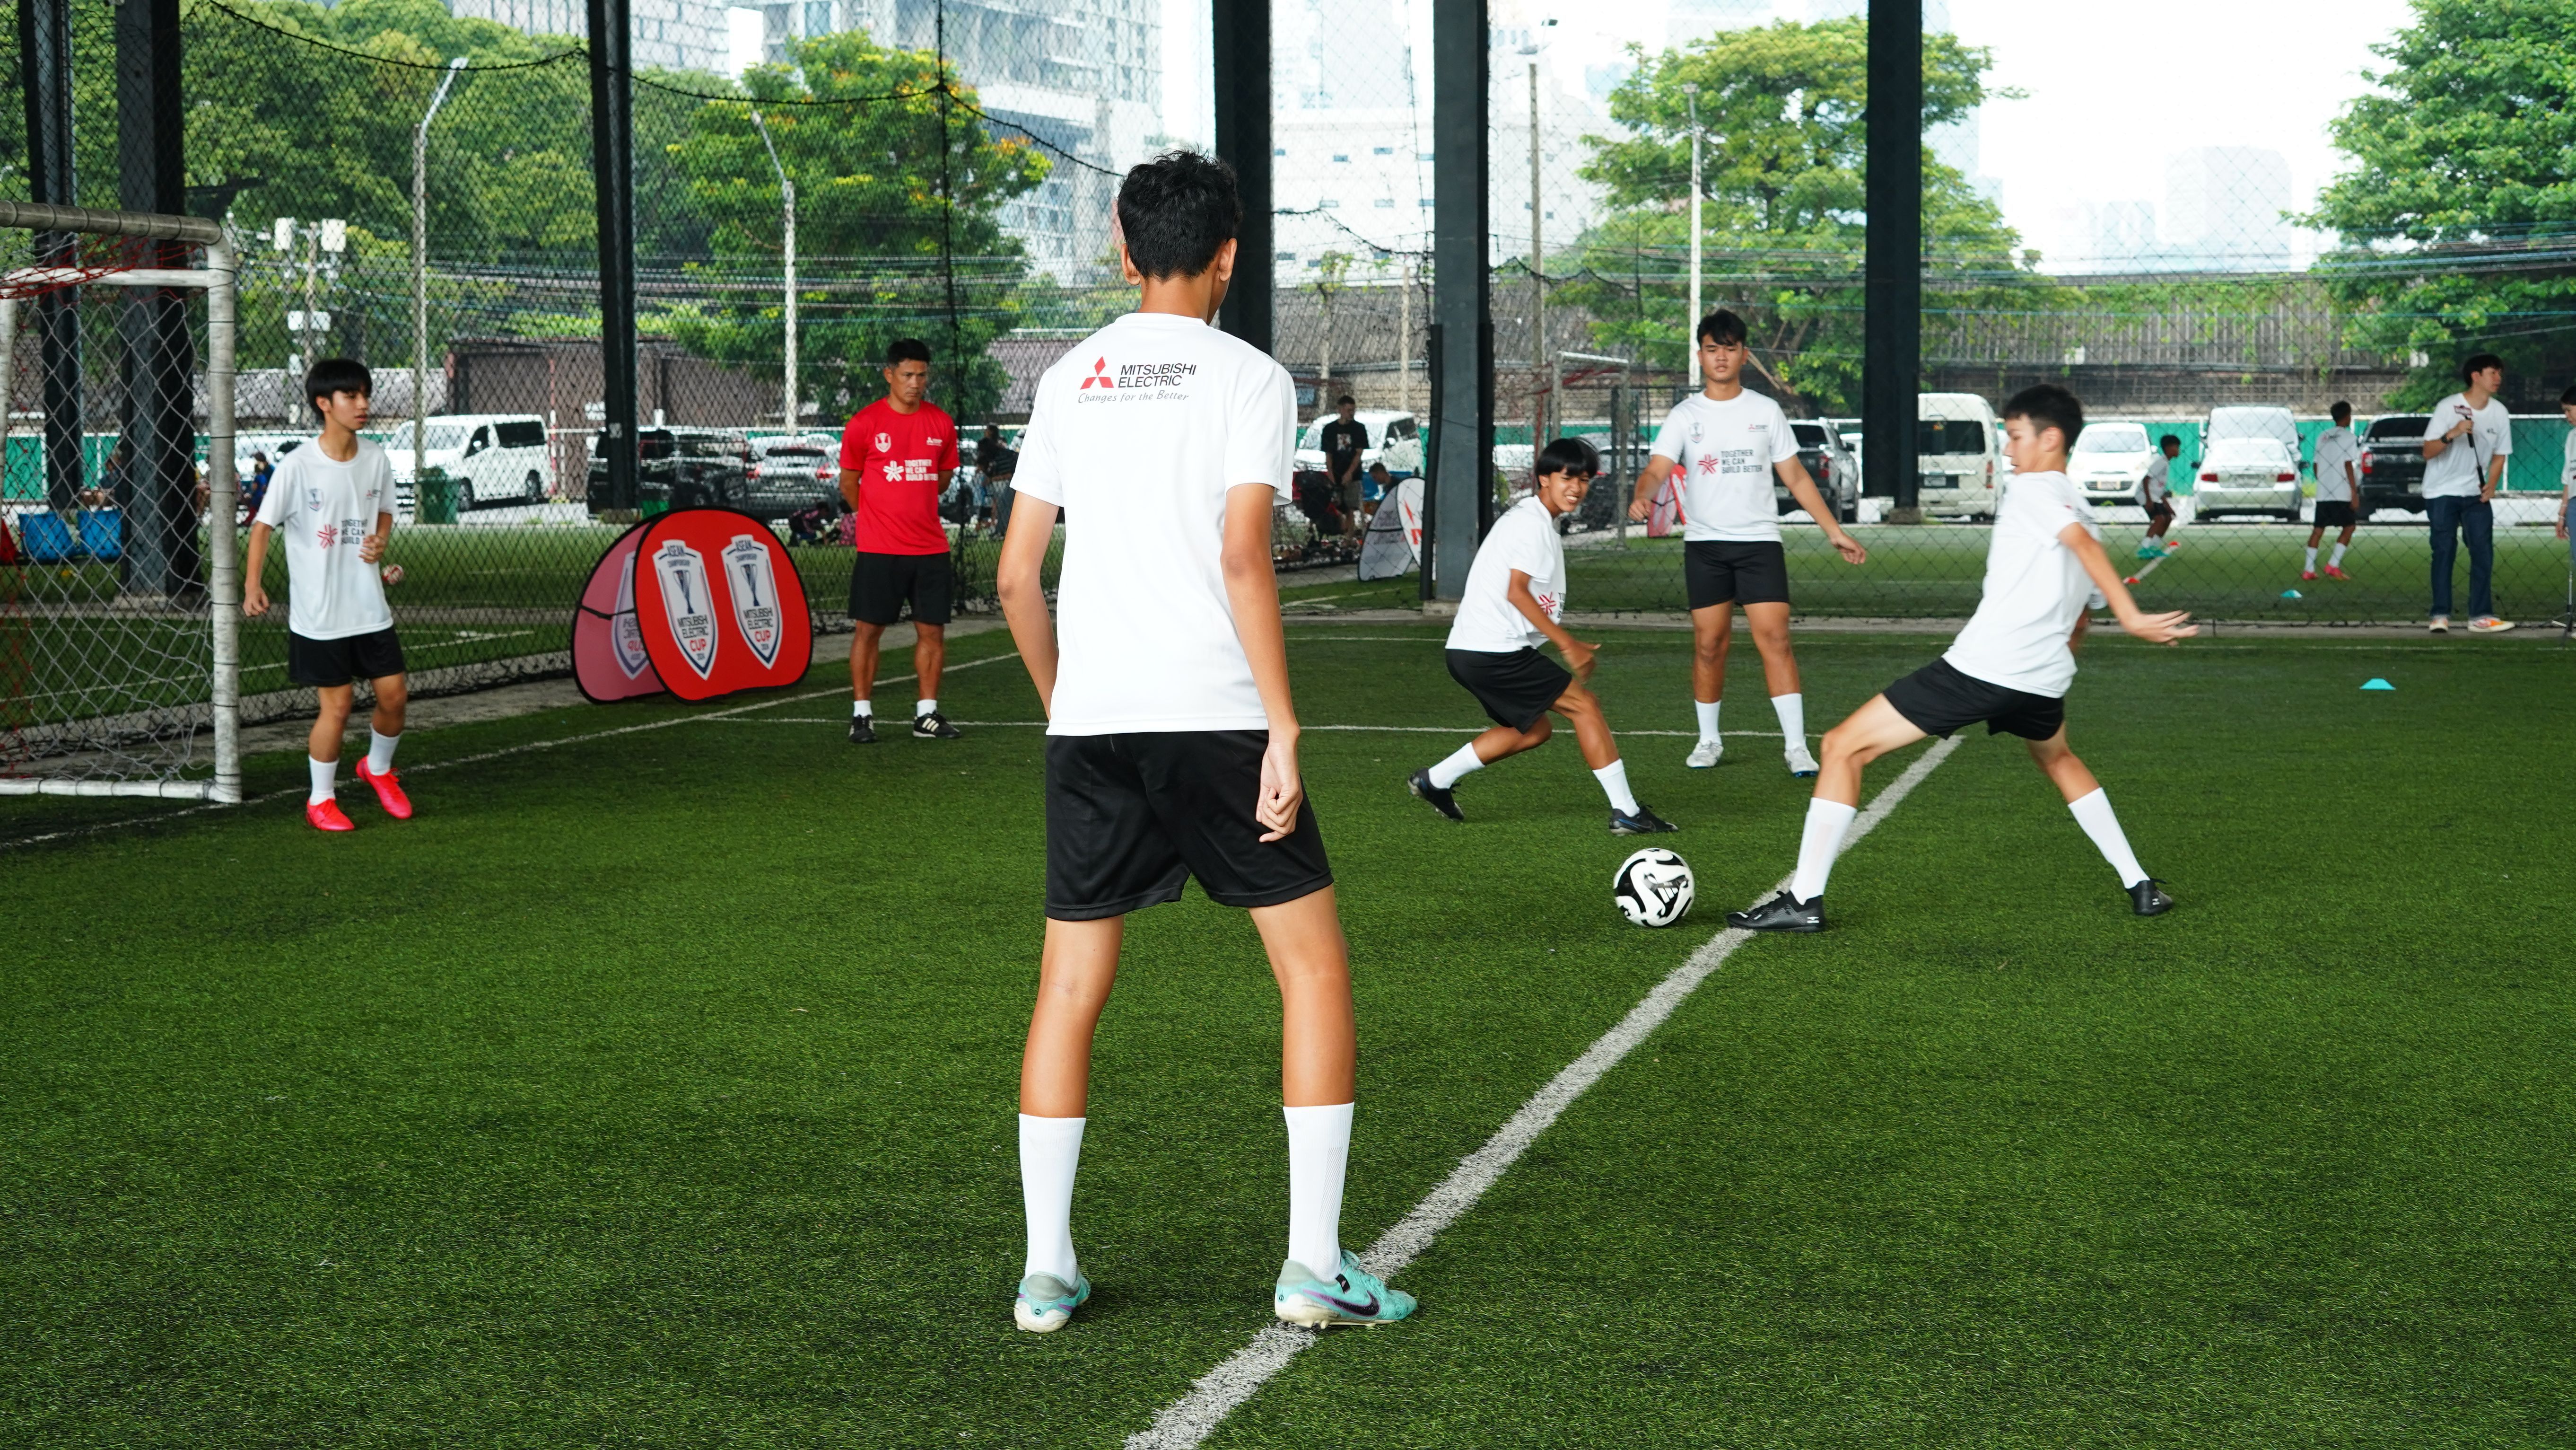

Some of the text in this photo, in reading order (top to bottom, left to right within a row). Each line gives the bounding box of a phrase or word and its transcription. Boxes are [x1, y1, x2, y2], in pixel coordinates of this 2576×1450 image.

[1120, 363, 1196, 376] MITSUBISHI
[1118, 375, 1182, 388] ELECTRIC
[1078, 390, 1189, 403] Changes for the Better
[755, 630, 771, 642] CUP
[690, 639, 707, 651] CUP
